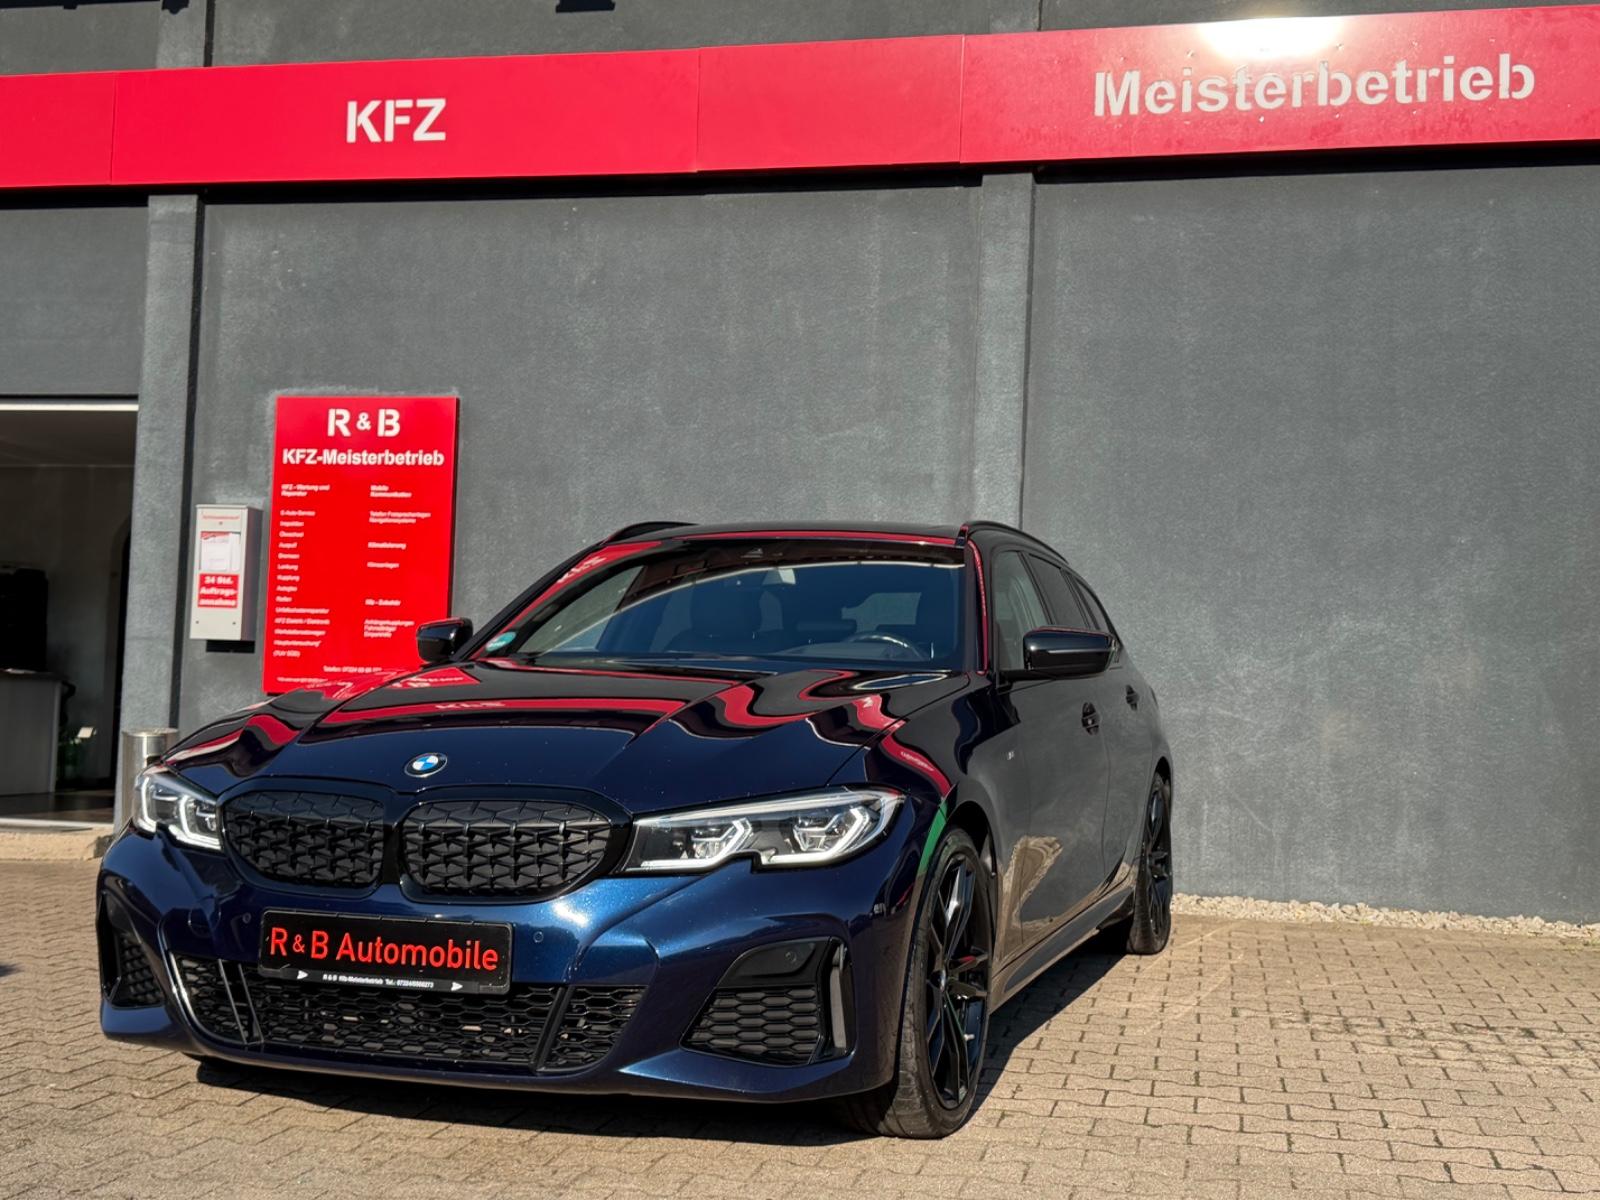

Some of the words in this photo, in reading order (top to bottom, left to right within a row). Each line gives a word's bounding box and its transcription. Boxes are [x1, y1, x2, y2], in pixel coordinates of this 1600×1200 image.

[346, 98, 447, 144] KFZ
[1093, 53, 1536, 118] Meisterbetrieb
[327, 408, 352, 437] R
[356, 411, 372, 431] &
[377, 408, 401, 437] B
[282, 448, 445, 466] KFZ-Meisterbetrieb
[270, 927, 288, 956] R
[292, 934, 305, 953] &
[311, 930, 328, 959] B
[336, 932, 498, 971] Automobile
